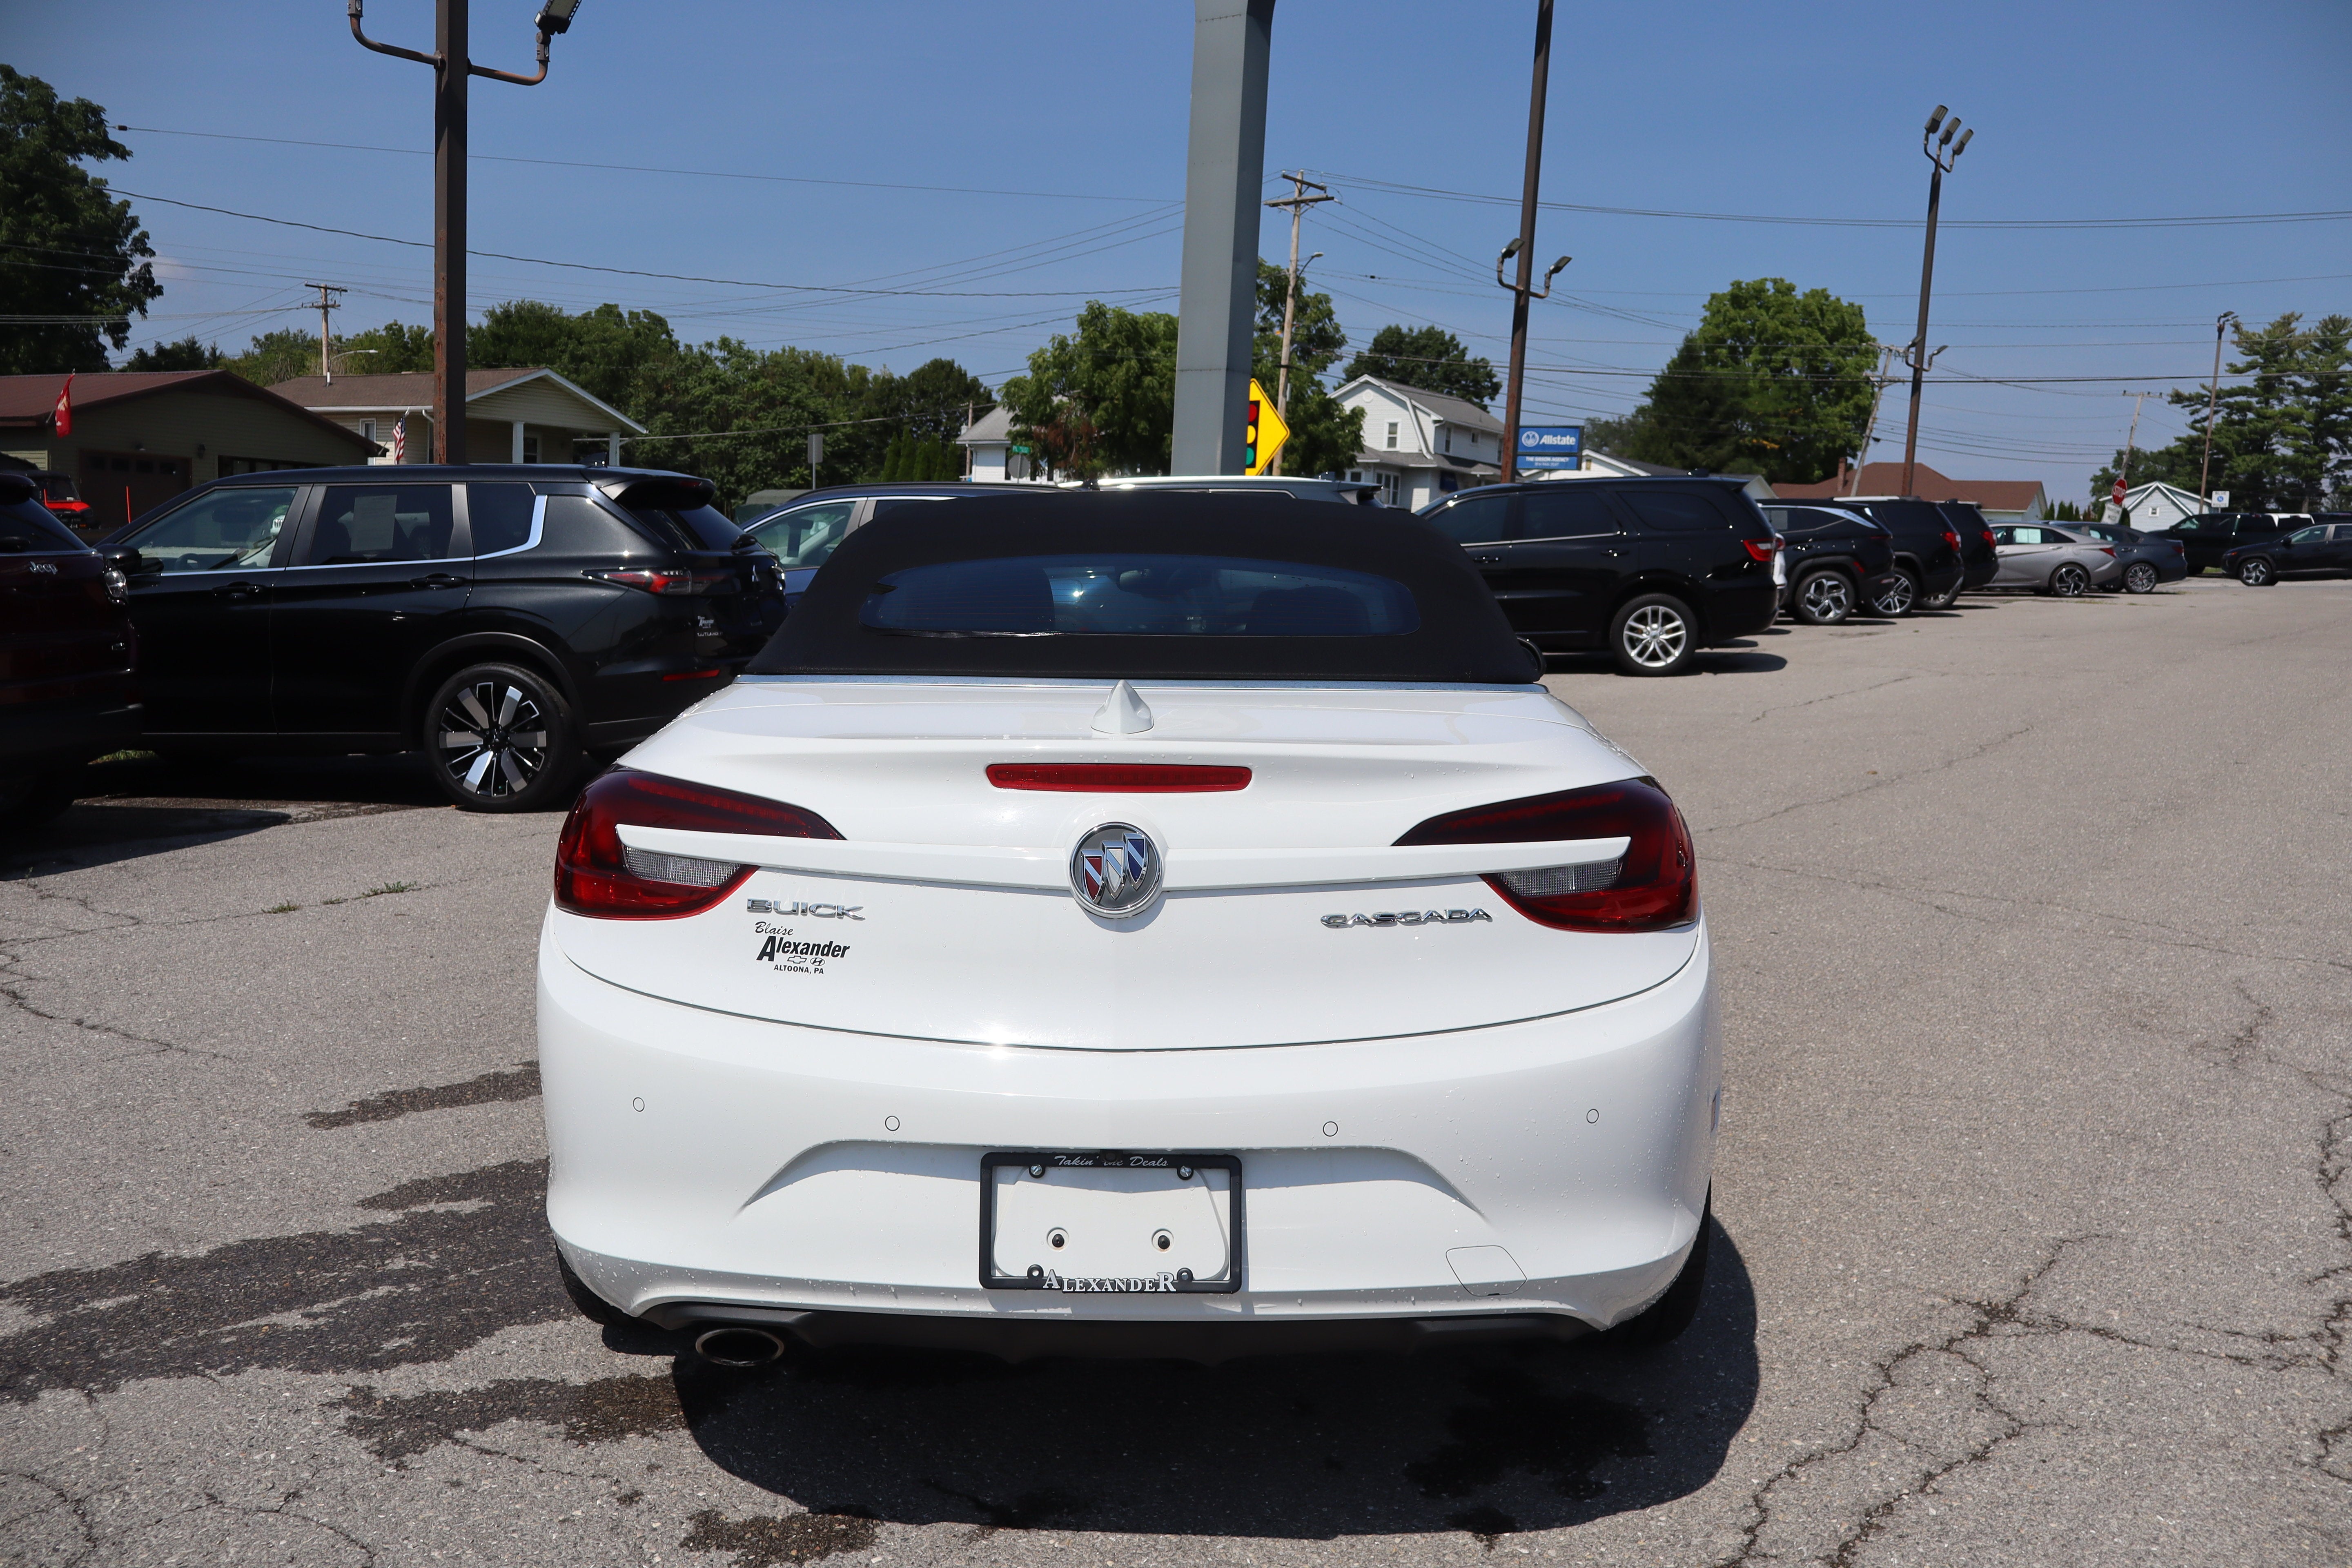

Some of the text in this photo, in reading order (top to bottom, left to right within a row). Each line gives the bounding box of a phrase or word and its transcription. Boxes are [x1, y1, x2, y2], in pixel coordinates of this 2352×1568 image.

[1539, 434, 1576, 445] Allstate
[2113, 485, 2126, 498] STOP
[29, 561, 58, 575] Jeep
[747, 898, 866, 921] BUICK
[1321, 908, 1493, 929] CASCADA
[755, 921, 793, 935] Blaise
[756, 935, 850, 962] Alexander
[774, 964, 812, 975] ALTOONA,
[1054, 1156, 1099, 1166] Takin'
[1129, 1156, 1169, 1167] Deals
[1042, 1269, 1177, 1292] ALEXANDER
